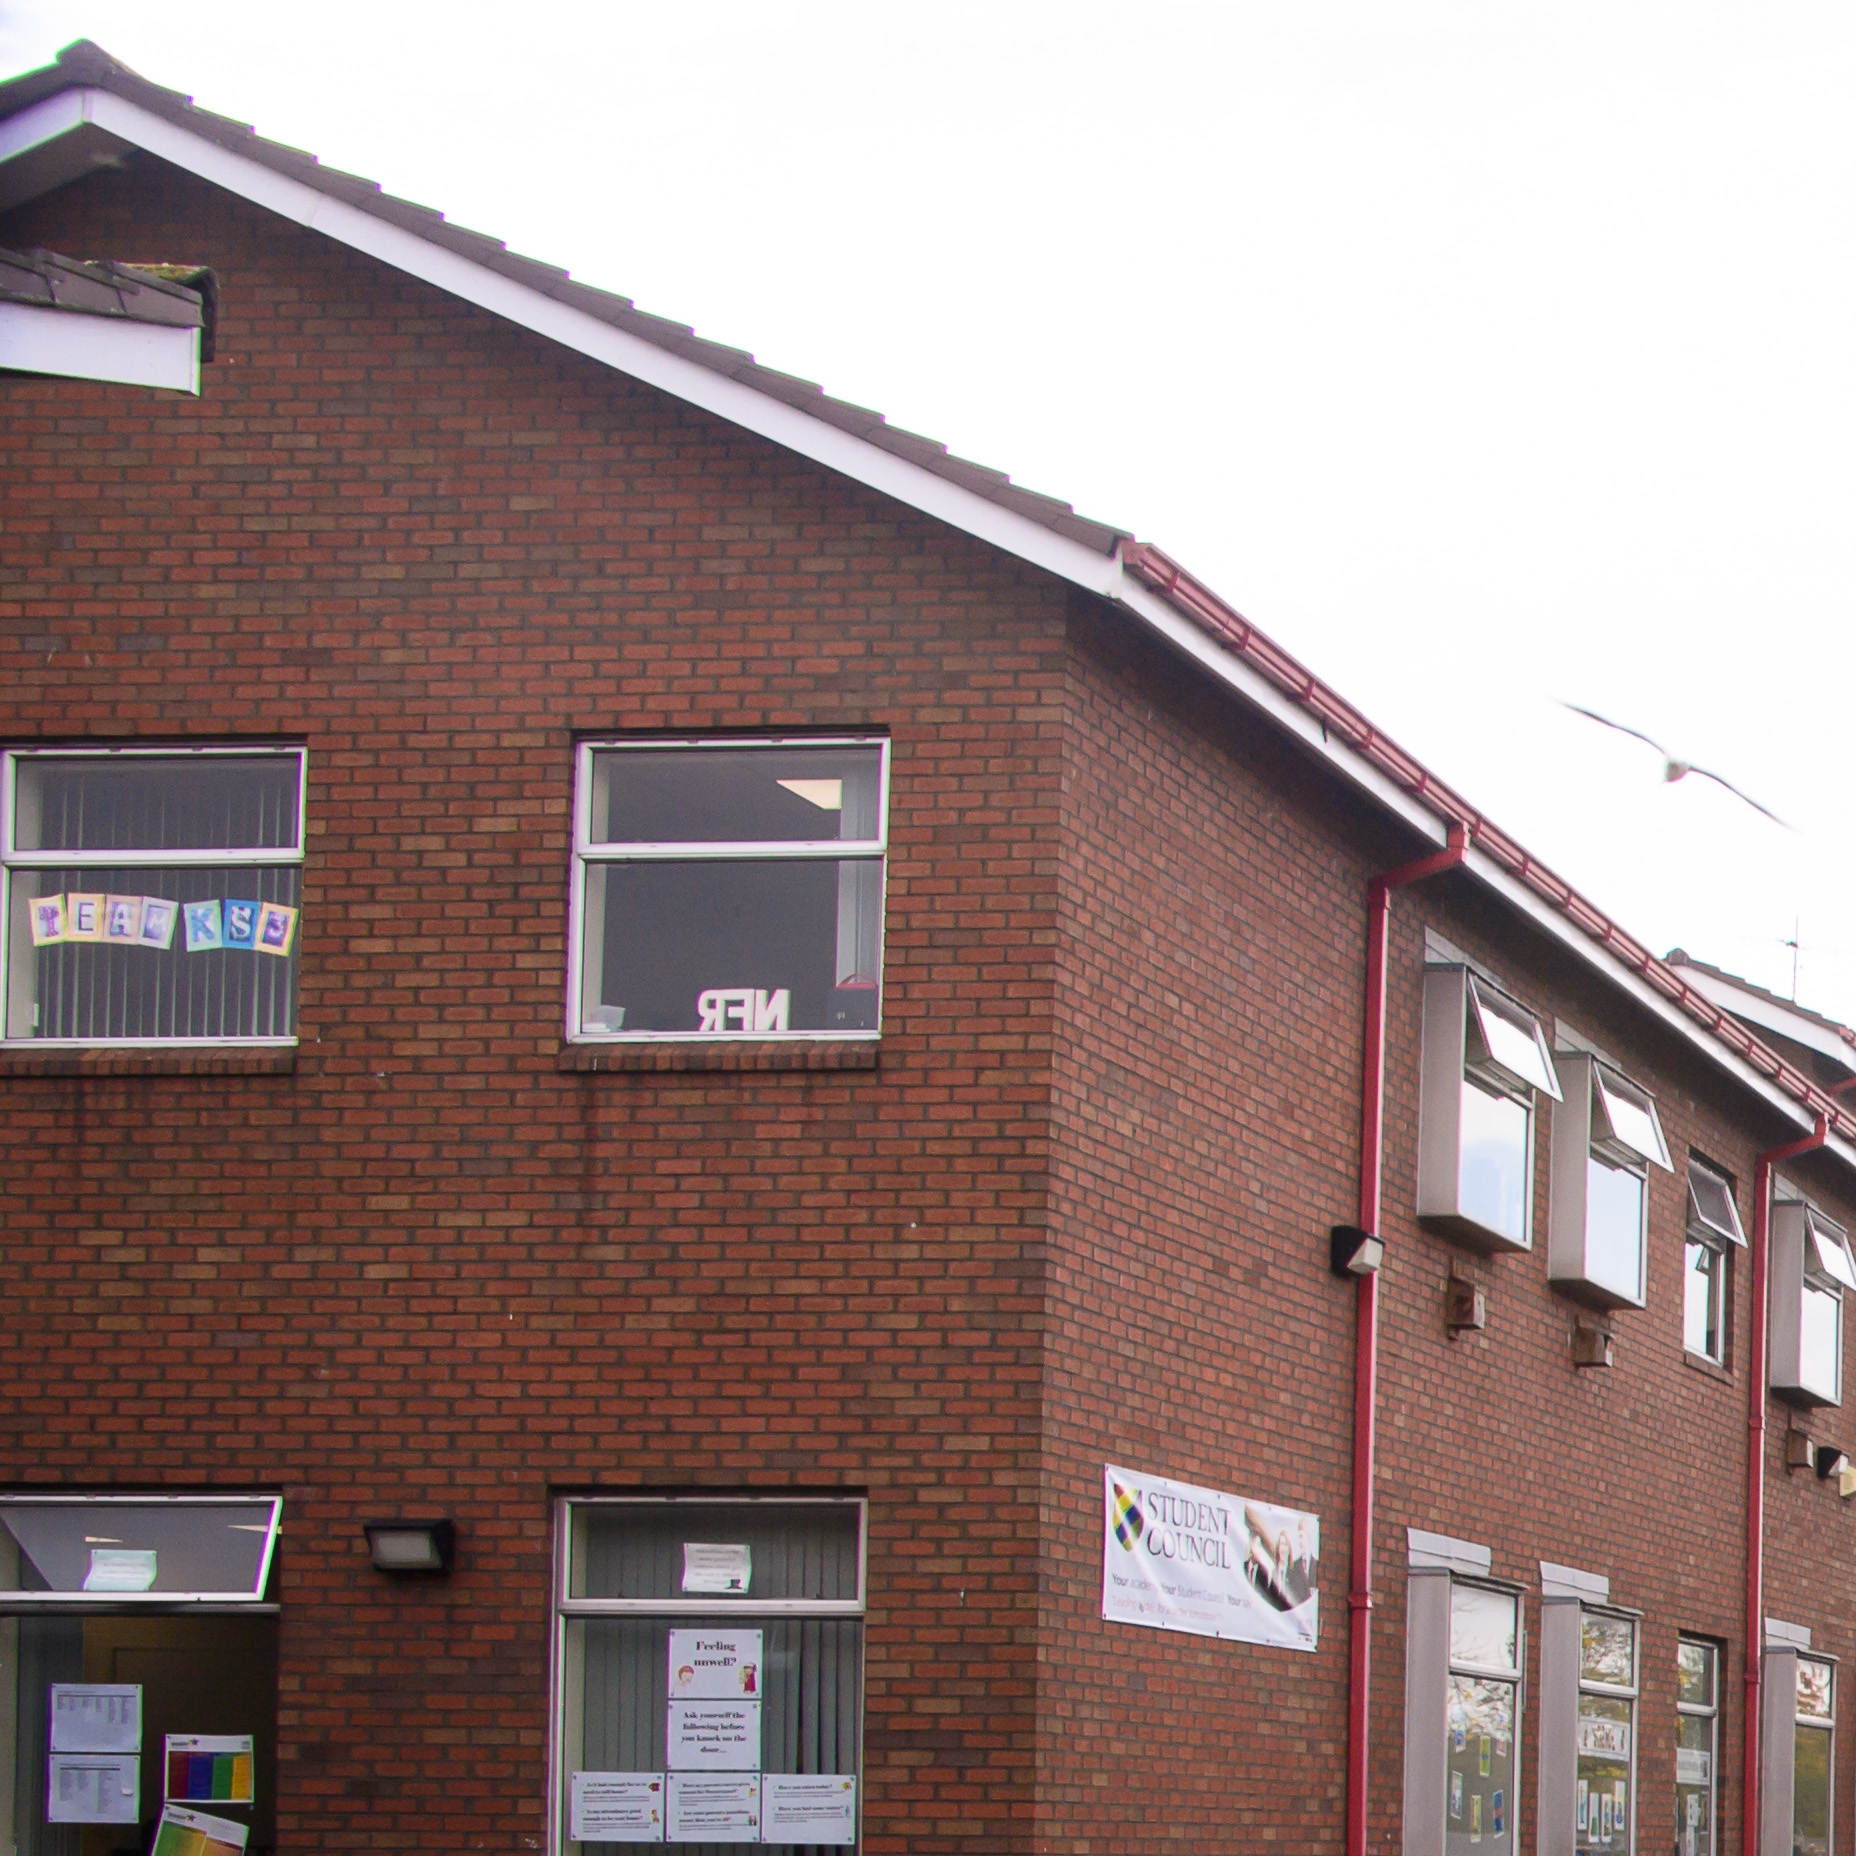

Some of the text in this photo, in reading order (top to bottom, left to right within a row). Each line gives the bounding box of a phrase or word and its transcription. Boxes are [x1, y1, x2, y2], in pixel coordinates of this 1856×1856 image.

[35, 899, 289, 945] TEAM KS3
[1148, 1491, 1231, 1536] STUDENT
[1147, 1527, 1231, 1570] COUNCIL
[696, 1641, 736, 1652] Feeling
[694, 1657, 736, 1667] unwell?
[700, 1712, 731, 1720] yourself
[682, 1723, 719, 1731] following
[681, 1736, 695, 1744] you
